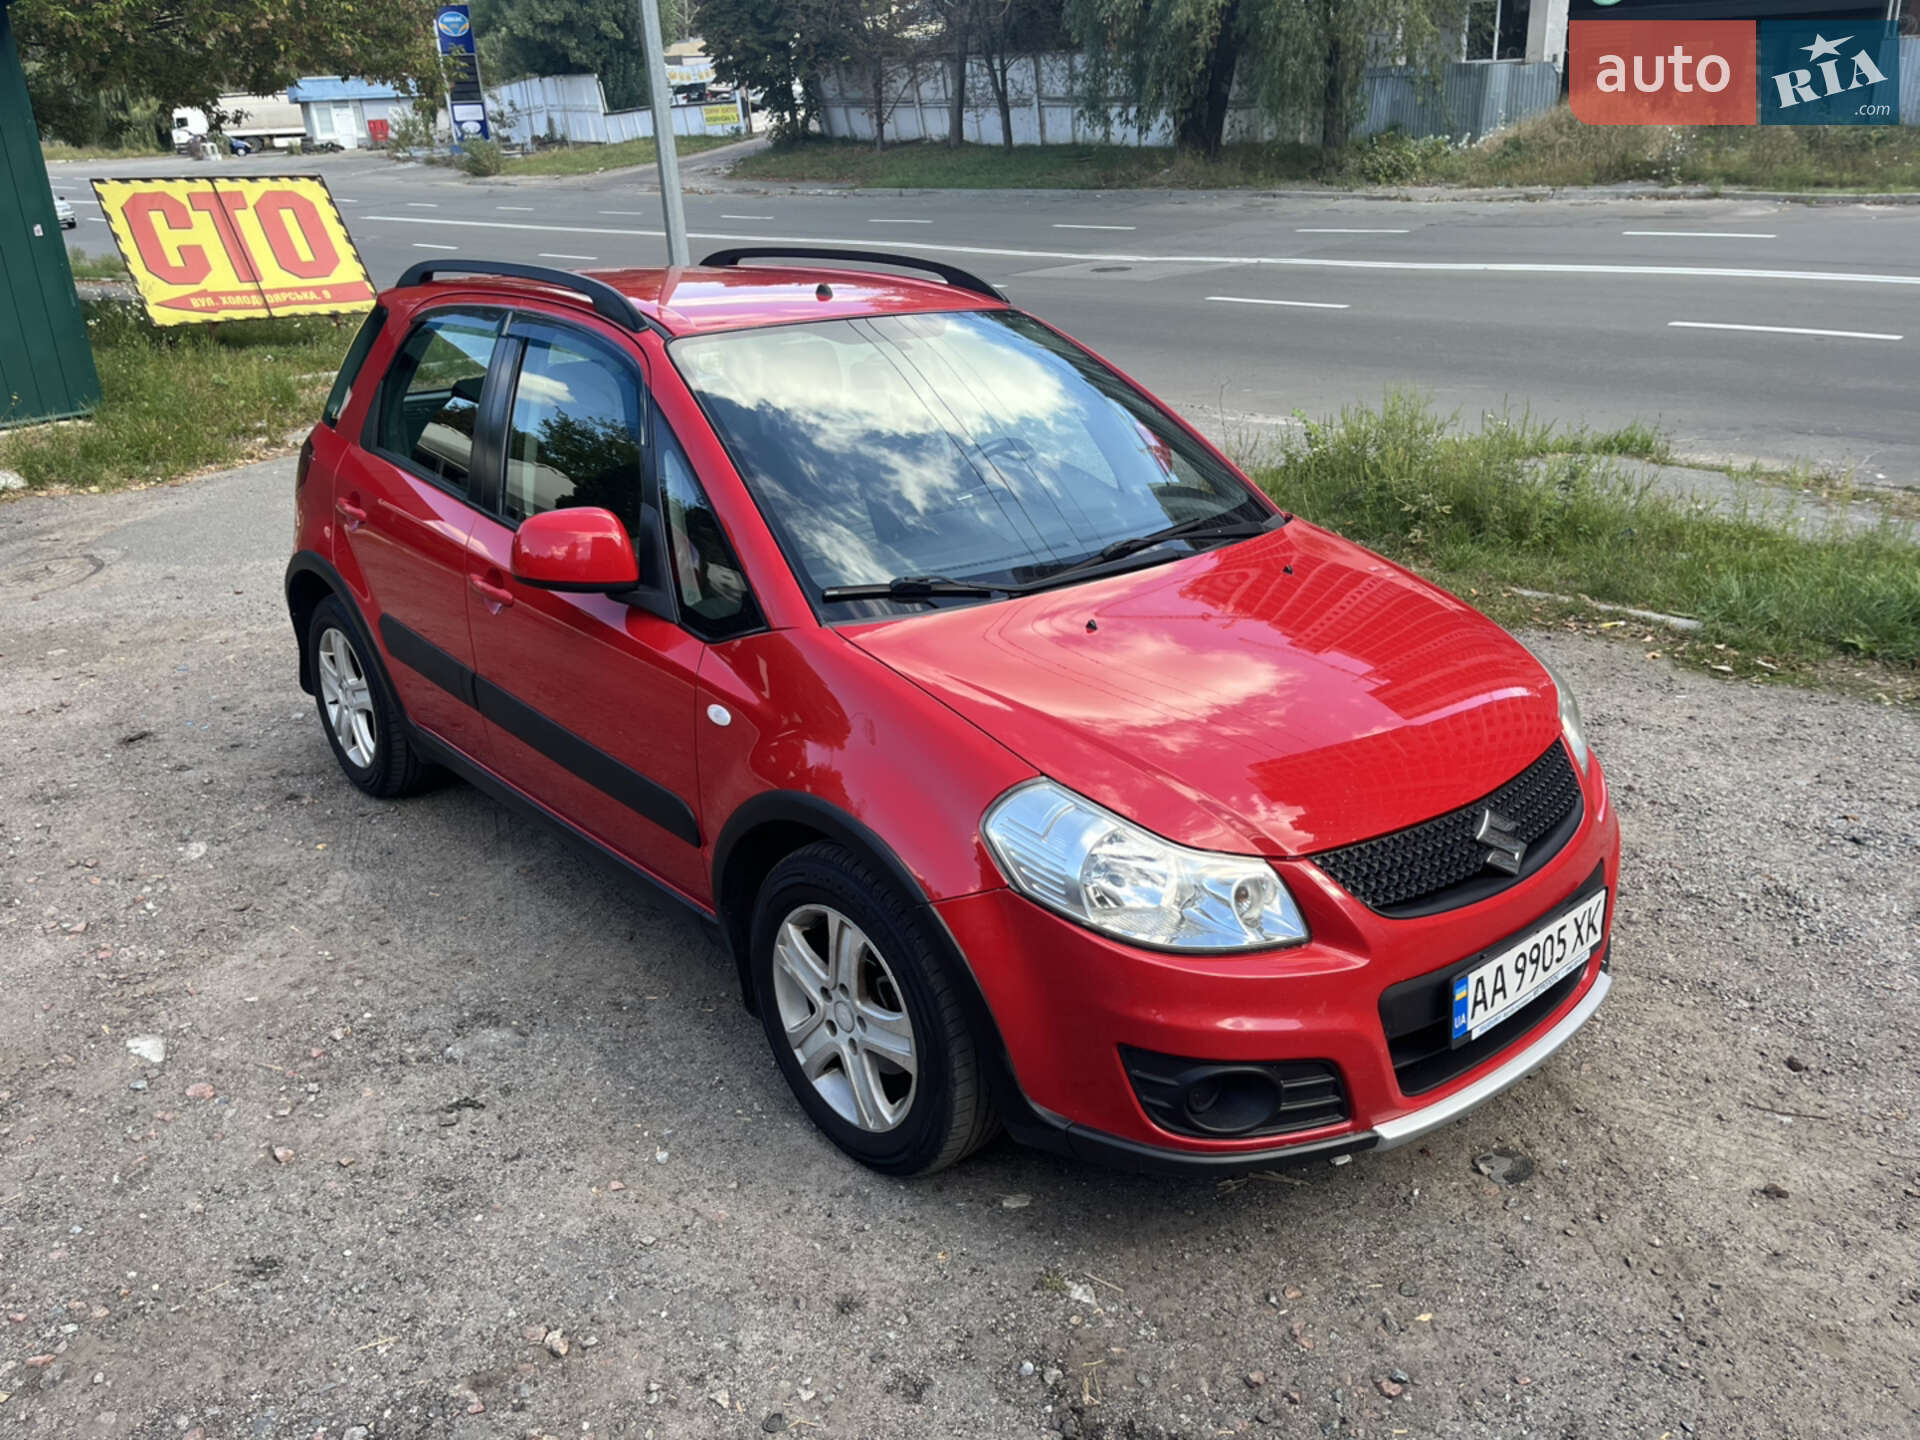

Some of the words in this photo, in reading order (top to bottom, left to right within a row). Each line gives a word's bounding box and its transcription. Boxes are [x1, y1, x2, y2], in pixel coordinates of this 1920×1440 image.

[121, 190, 340, 285] СТО
[1471, 964, 1507, 1020] AA
[1514, 925, 1567, 993] 9905
[1572, 900, 1602, 954] XK
[1454, 1012, 1467, 1029] UA
